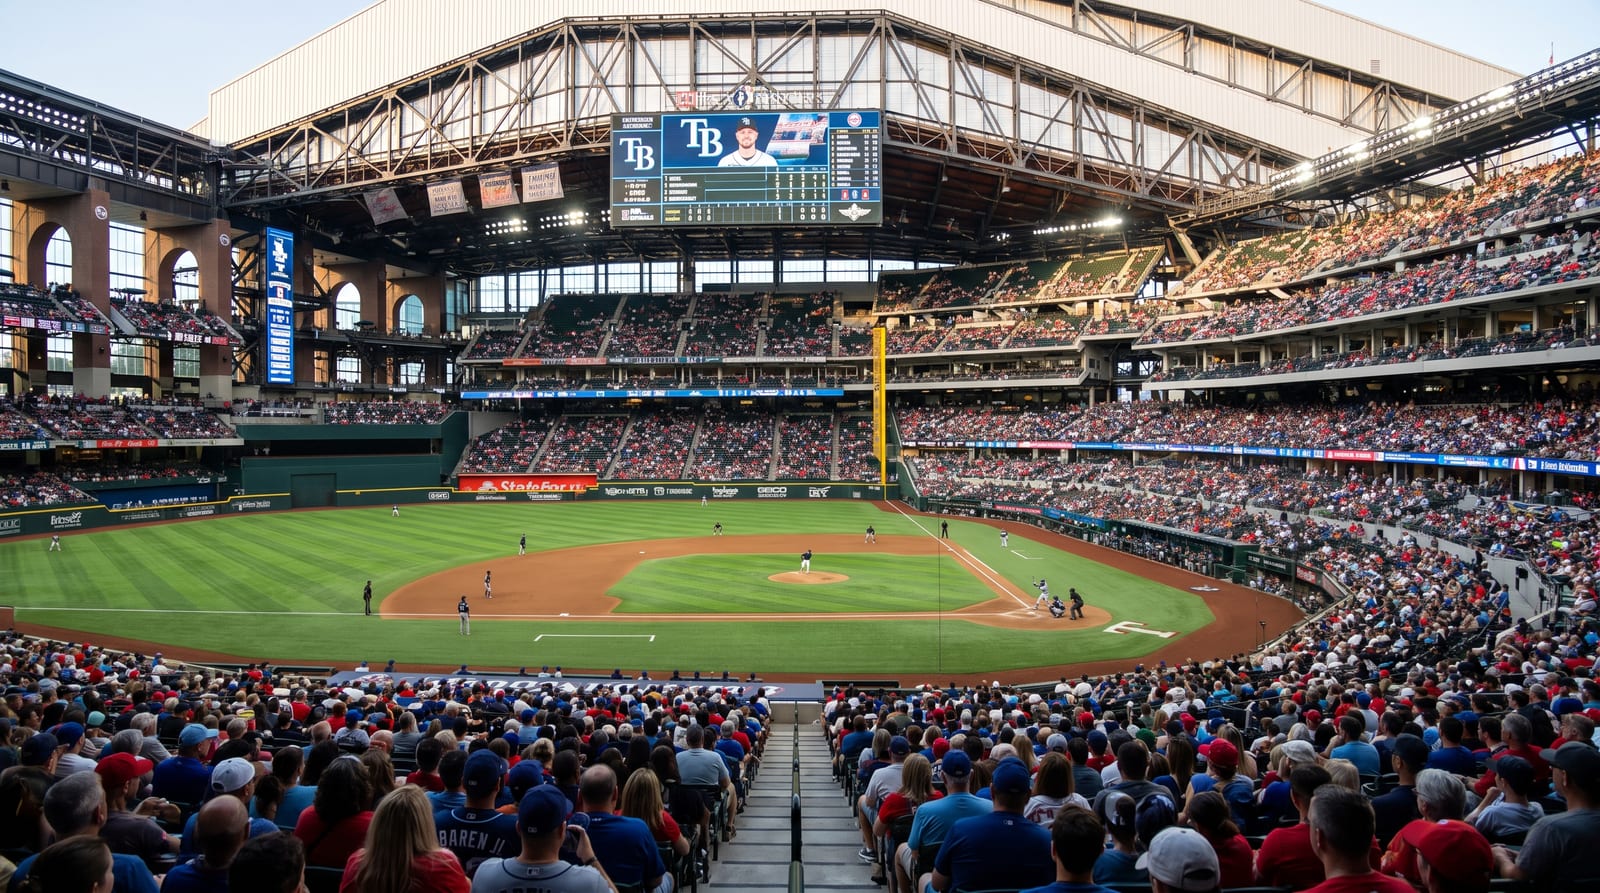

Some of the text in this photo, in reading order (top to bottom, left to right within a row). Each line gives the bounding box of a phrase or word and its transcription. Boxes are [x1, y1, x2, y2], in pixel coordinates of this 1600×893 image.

[619, 137, 655, 171] TB
[680, 118, 723, 157] TB
[439, 829, 488, 850] BAREN
